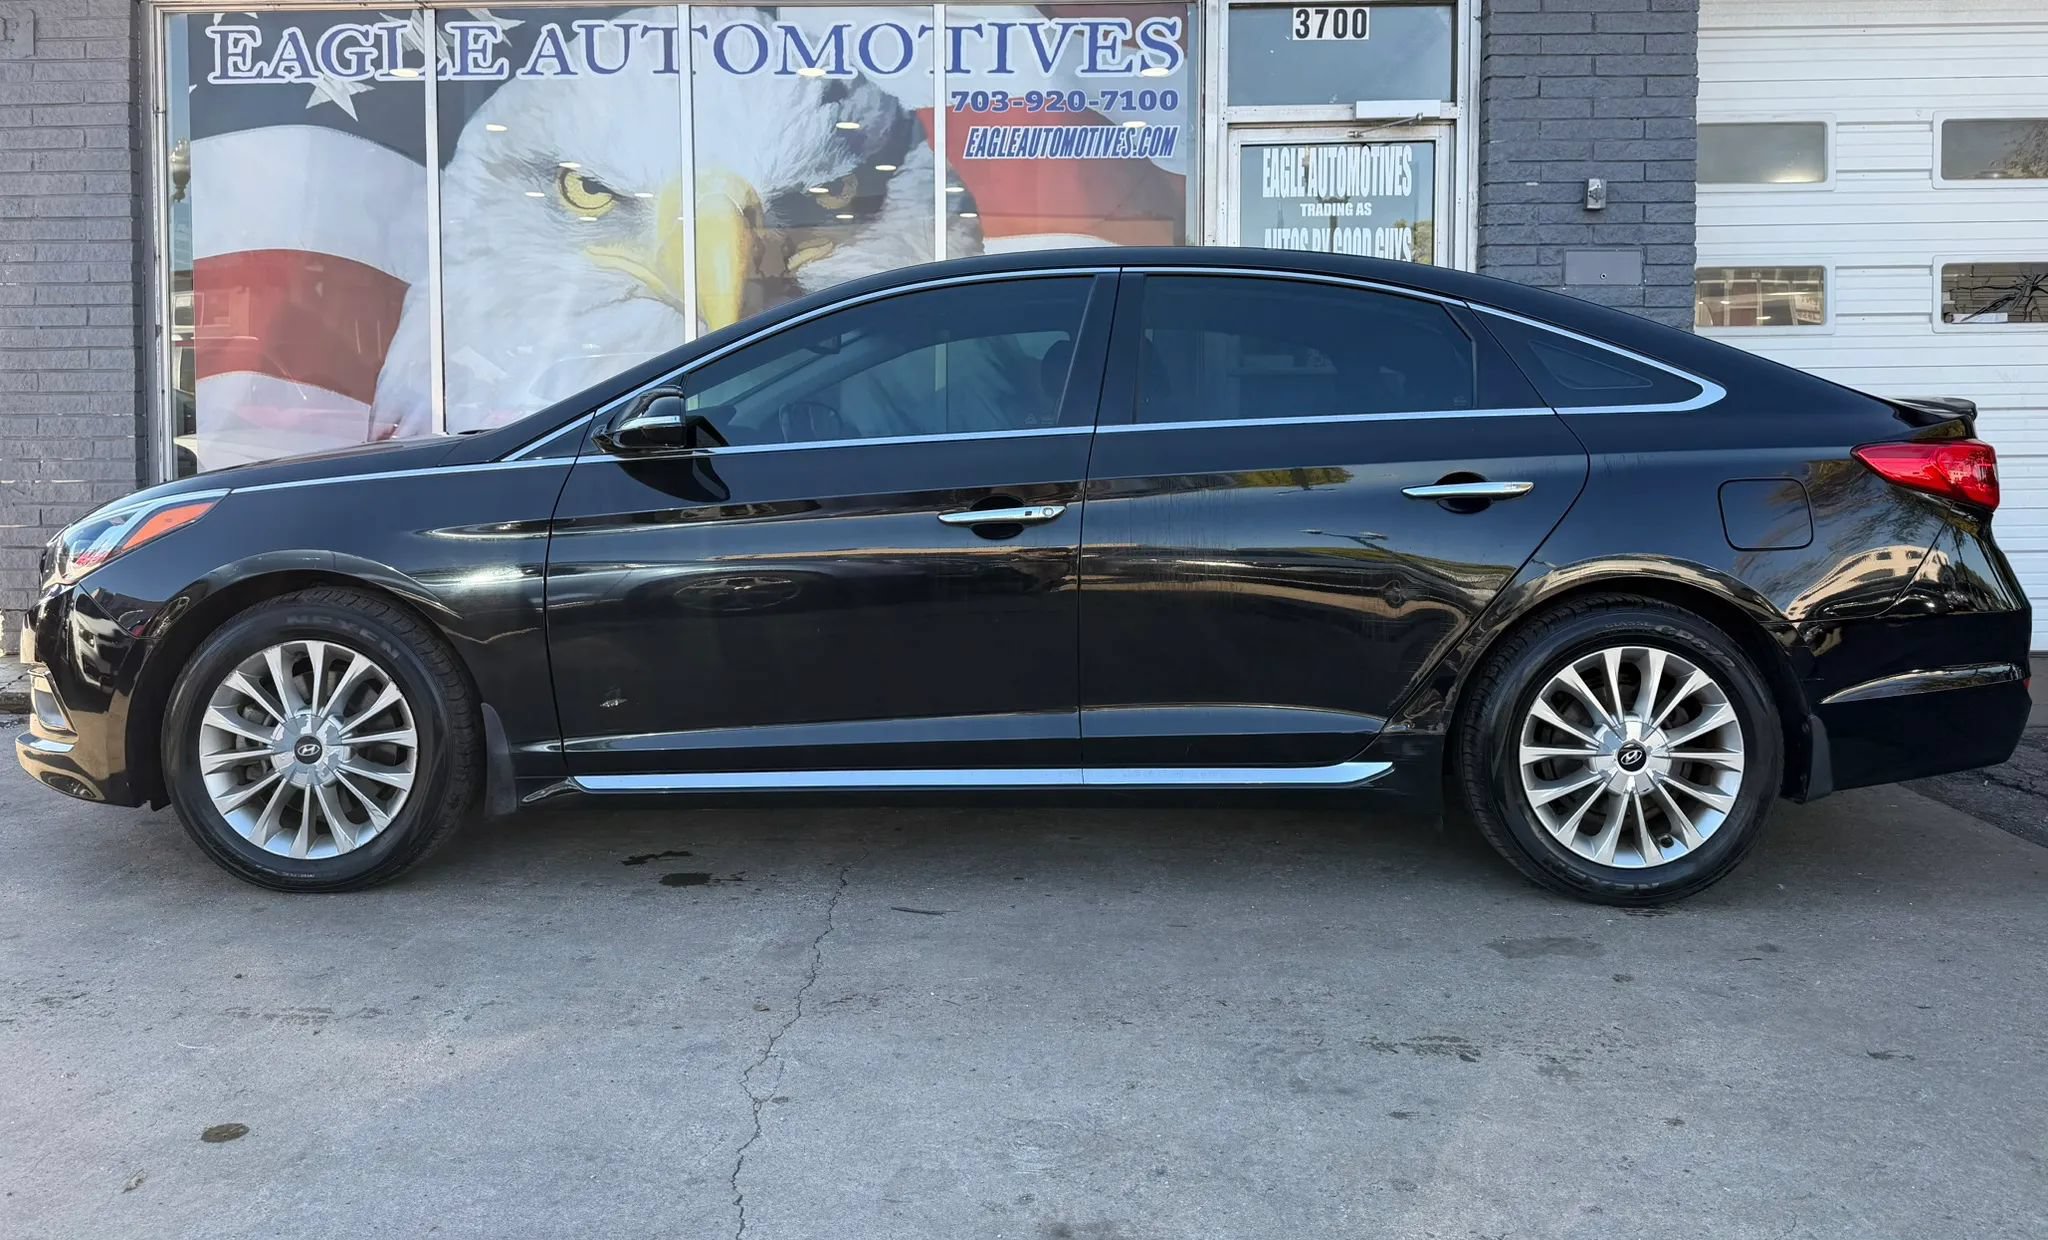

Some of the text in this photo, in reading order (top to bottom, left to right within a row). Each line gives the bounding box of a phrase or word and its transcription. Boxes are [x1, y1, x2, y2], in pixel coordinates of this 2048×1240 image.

[1295, 9, 1367, 39] 3700
[207, 19, 1185, 83] EAGLE AUTOMOTIVES
[950, 89, 1179, 113] 703-920-7100
[963, 125, 1177, 159] EAGLEAUTOMOTIVES.COM
[1263, 145, 1413, 198] EAGLE AUTOMOTIVES
[1300, 202, 1373, 216] TRADING AS
